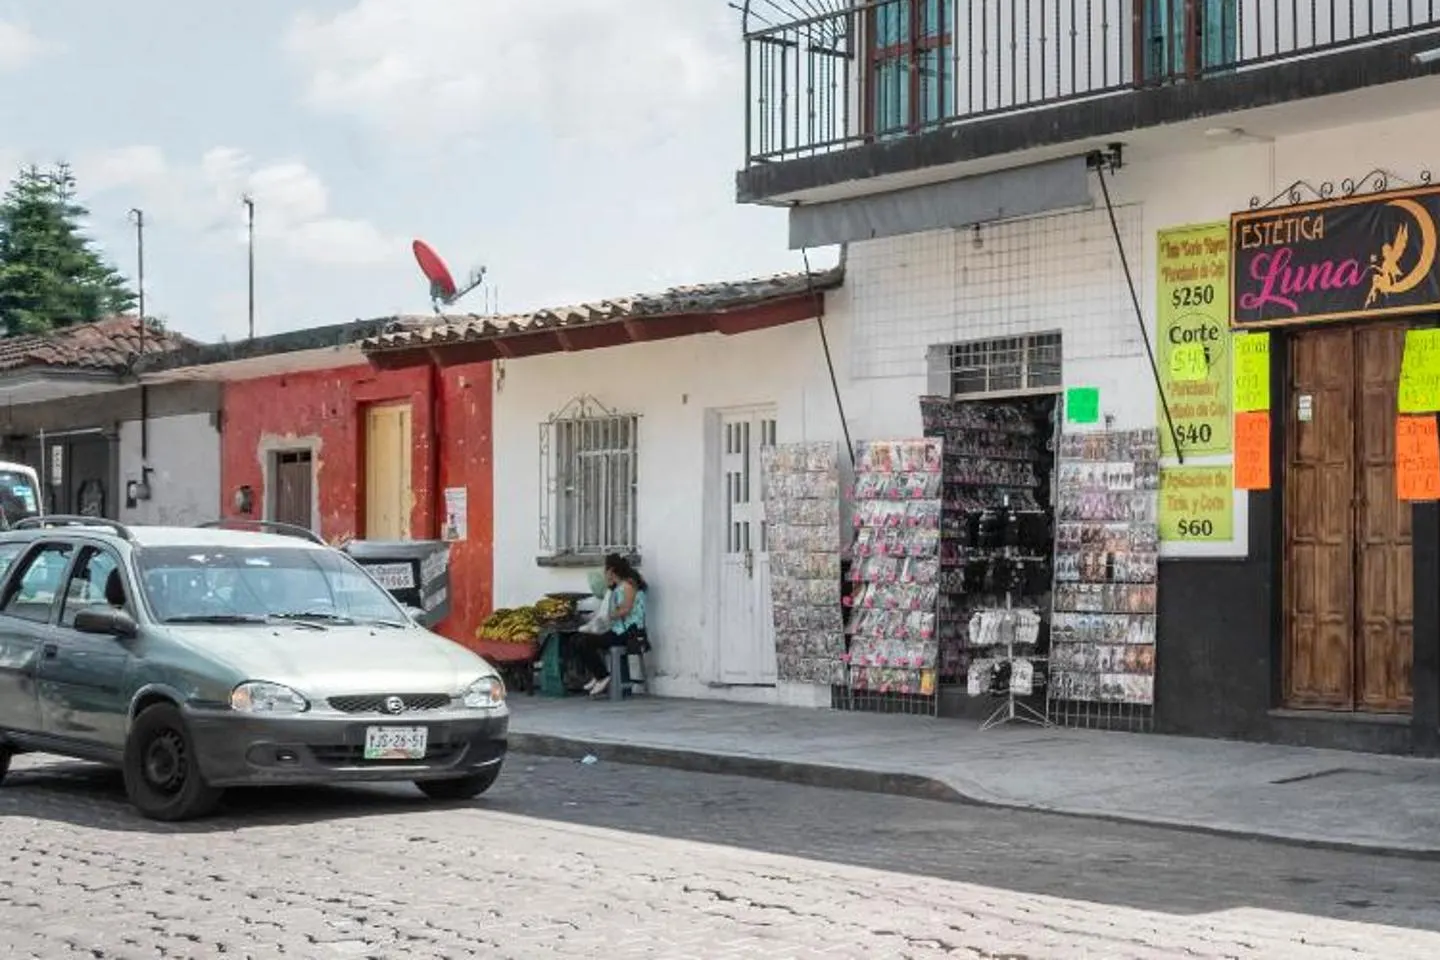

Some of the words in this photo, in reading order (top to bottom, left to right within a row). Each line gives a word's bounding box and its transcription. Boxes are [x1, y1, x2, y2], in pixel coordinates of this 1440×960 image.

[1239, 247, 1370, 314] Luna
[1172, 284, 1214, 309] $250
[1169, 324, 1219, 344] Corte
[1176, 424, 1212, 445] $40
[1178, 518, 1213, 537] $60
